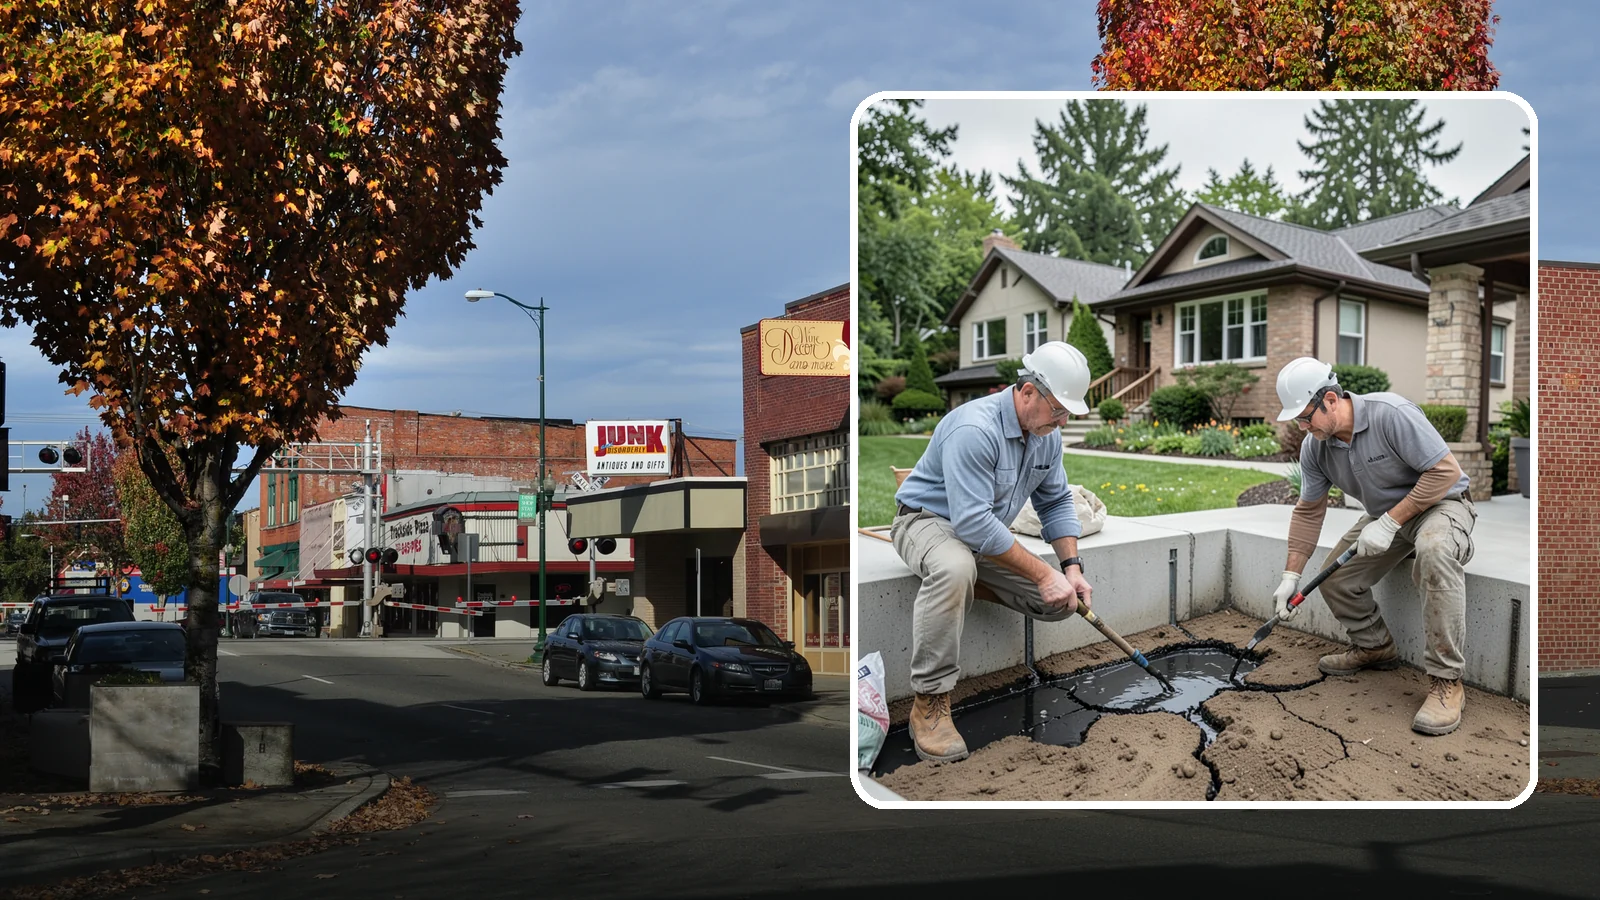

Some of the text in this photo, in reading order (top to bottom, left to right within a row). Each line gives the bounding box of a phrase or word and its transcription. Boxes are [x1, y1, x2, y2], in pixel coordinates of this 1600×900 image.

[595, 425, 665, 457] JUNK
[607, 446, 646, 454] DISORDERLY
[597, 460, 665, 470] ANTIQUES AND GIFTS
[390, 519, 429, 540] Trackside Pizza
